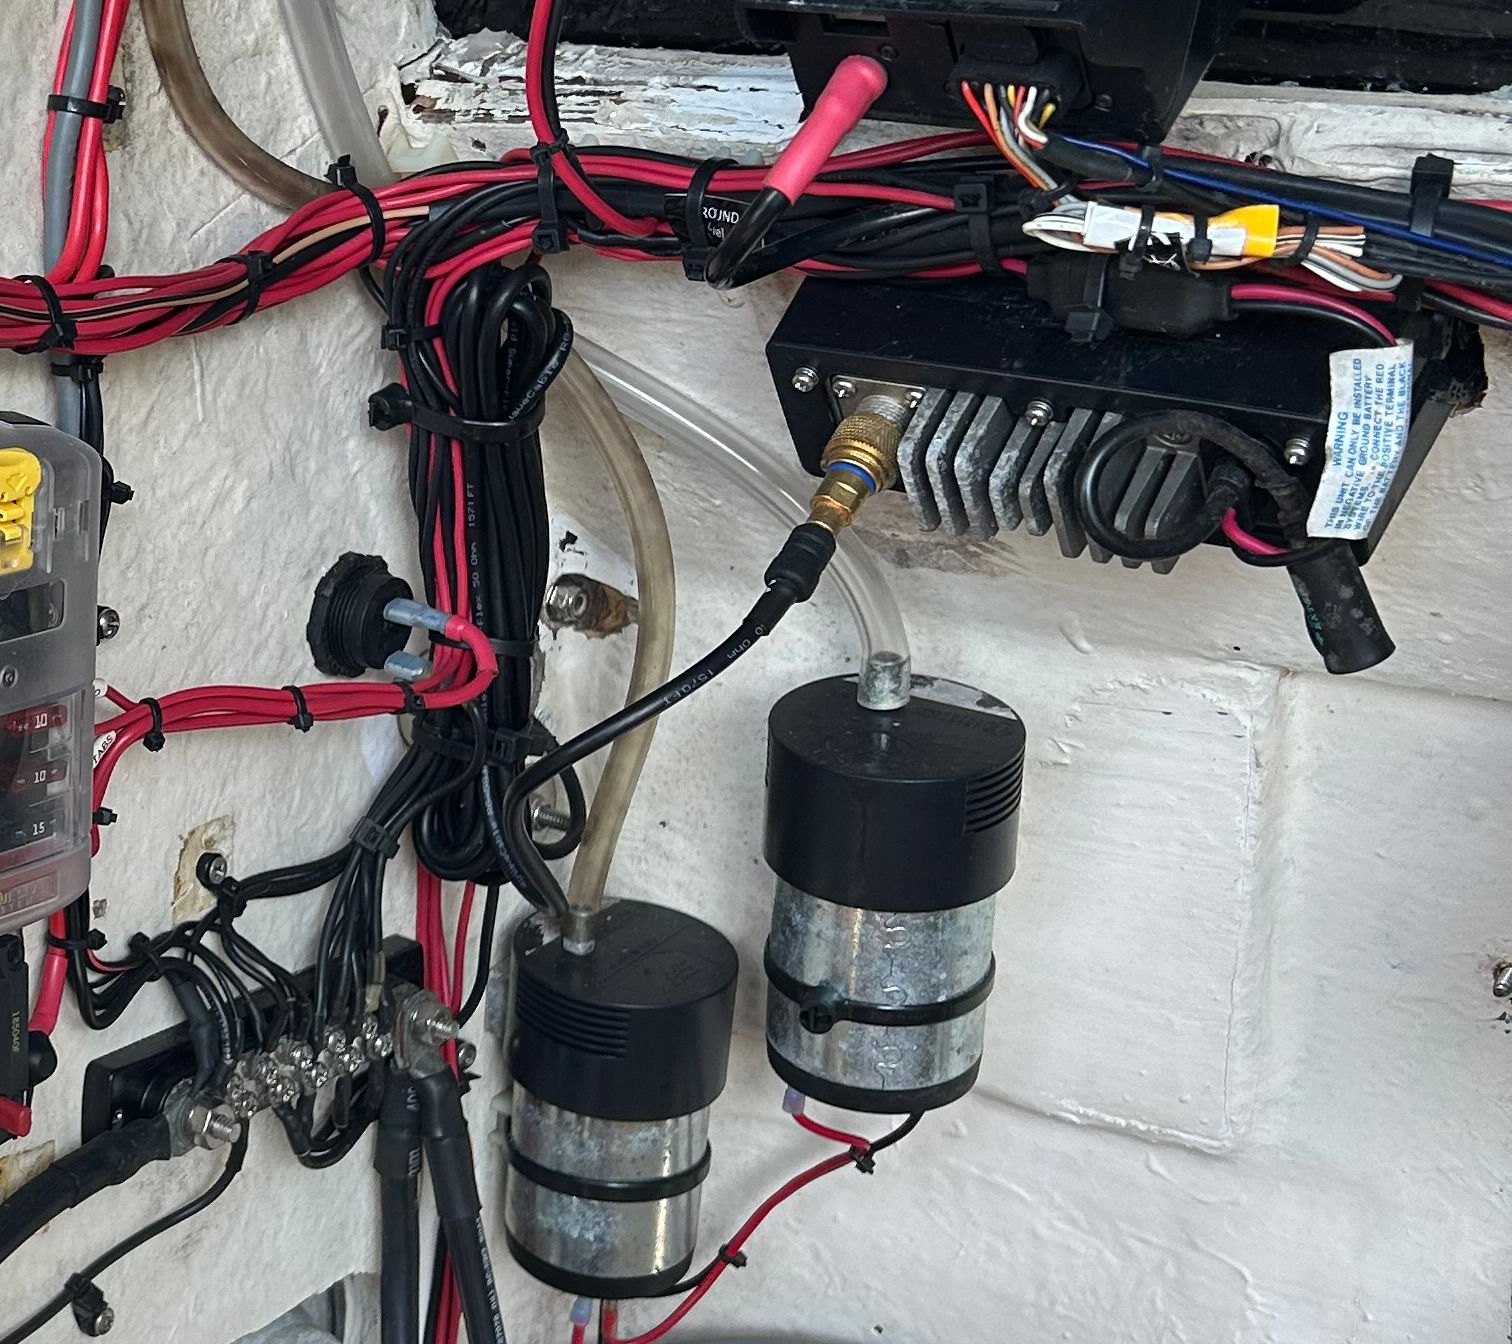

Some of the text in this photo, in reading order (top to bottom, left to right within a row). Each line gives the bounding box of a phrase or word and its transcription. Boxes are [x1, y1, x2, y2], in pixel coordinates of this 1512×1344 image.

[1352, 358, 1362, 409] INSTALLED
[1397, 361, 1407, 397] BLACK
[1362, 375, 1373, 421] BATTERY
[1371, 363, 1385, 461] CONNECT THE RED
[1352, 413, 1361, 426] BE
[1332, 411, 1349, 467] WARNING
[1347, 429, 1360, 456] ONLY
[1354, 506, 1369, 530] WIRE
[1384, 363, 1397, 418] TERMINAL
[1345, 455, 1356, 479] CAN
[34, 712, 48, 728] 10
[33, 769, 47, 784] 10
[31, 821, 45, 836] 15
